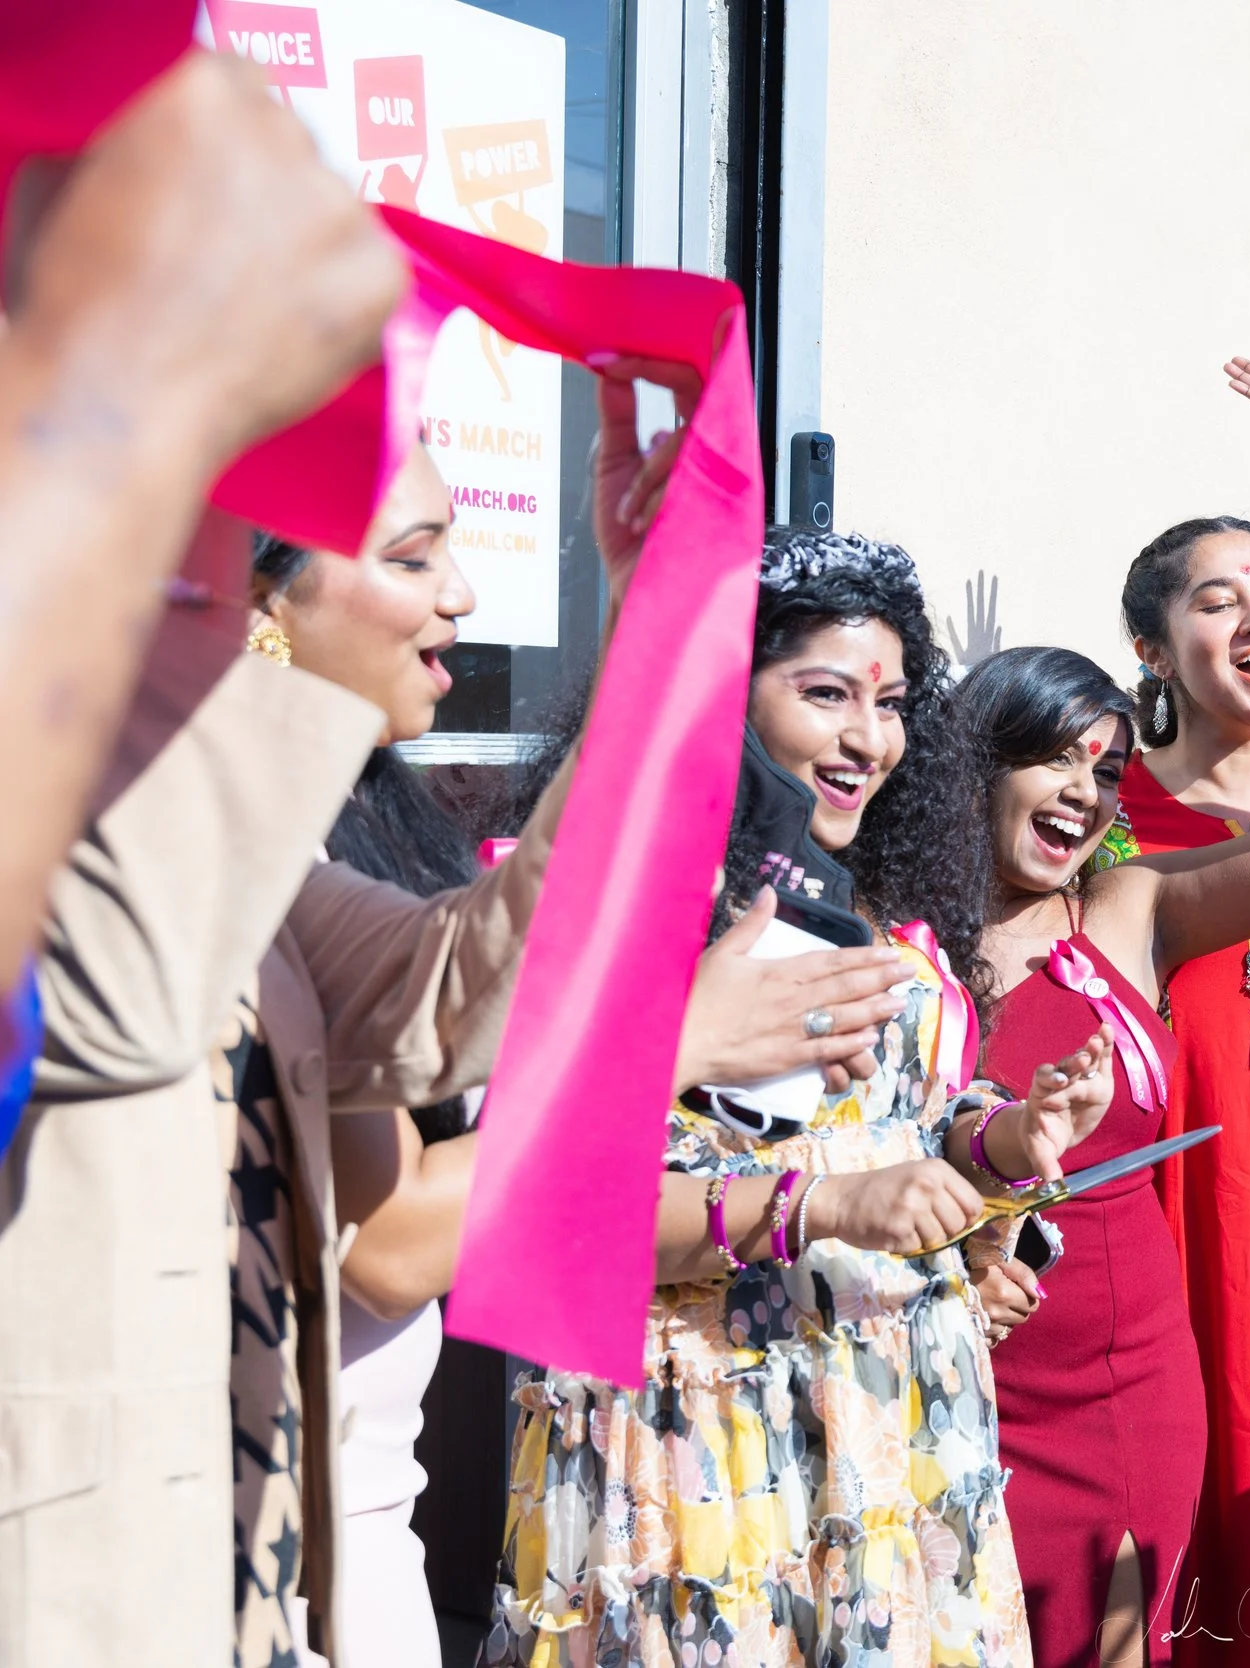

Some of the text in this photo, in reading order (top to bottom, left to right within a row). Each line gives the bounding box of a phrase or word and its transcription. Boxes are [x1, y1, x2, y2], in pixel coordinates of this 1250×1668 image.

[228, 31, 315, 66] VOICE
[368, 96, 415, 127] OUR
[461, 140, 541, 181] POWER
[459, 421, 542, 461] MARCH
